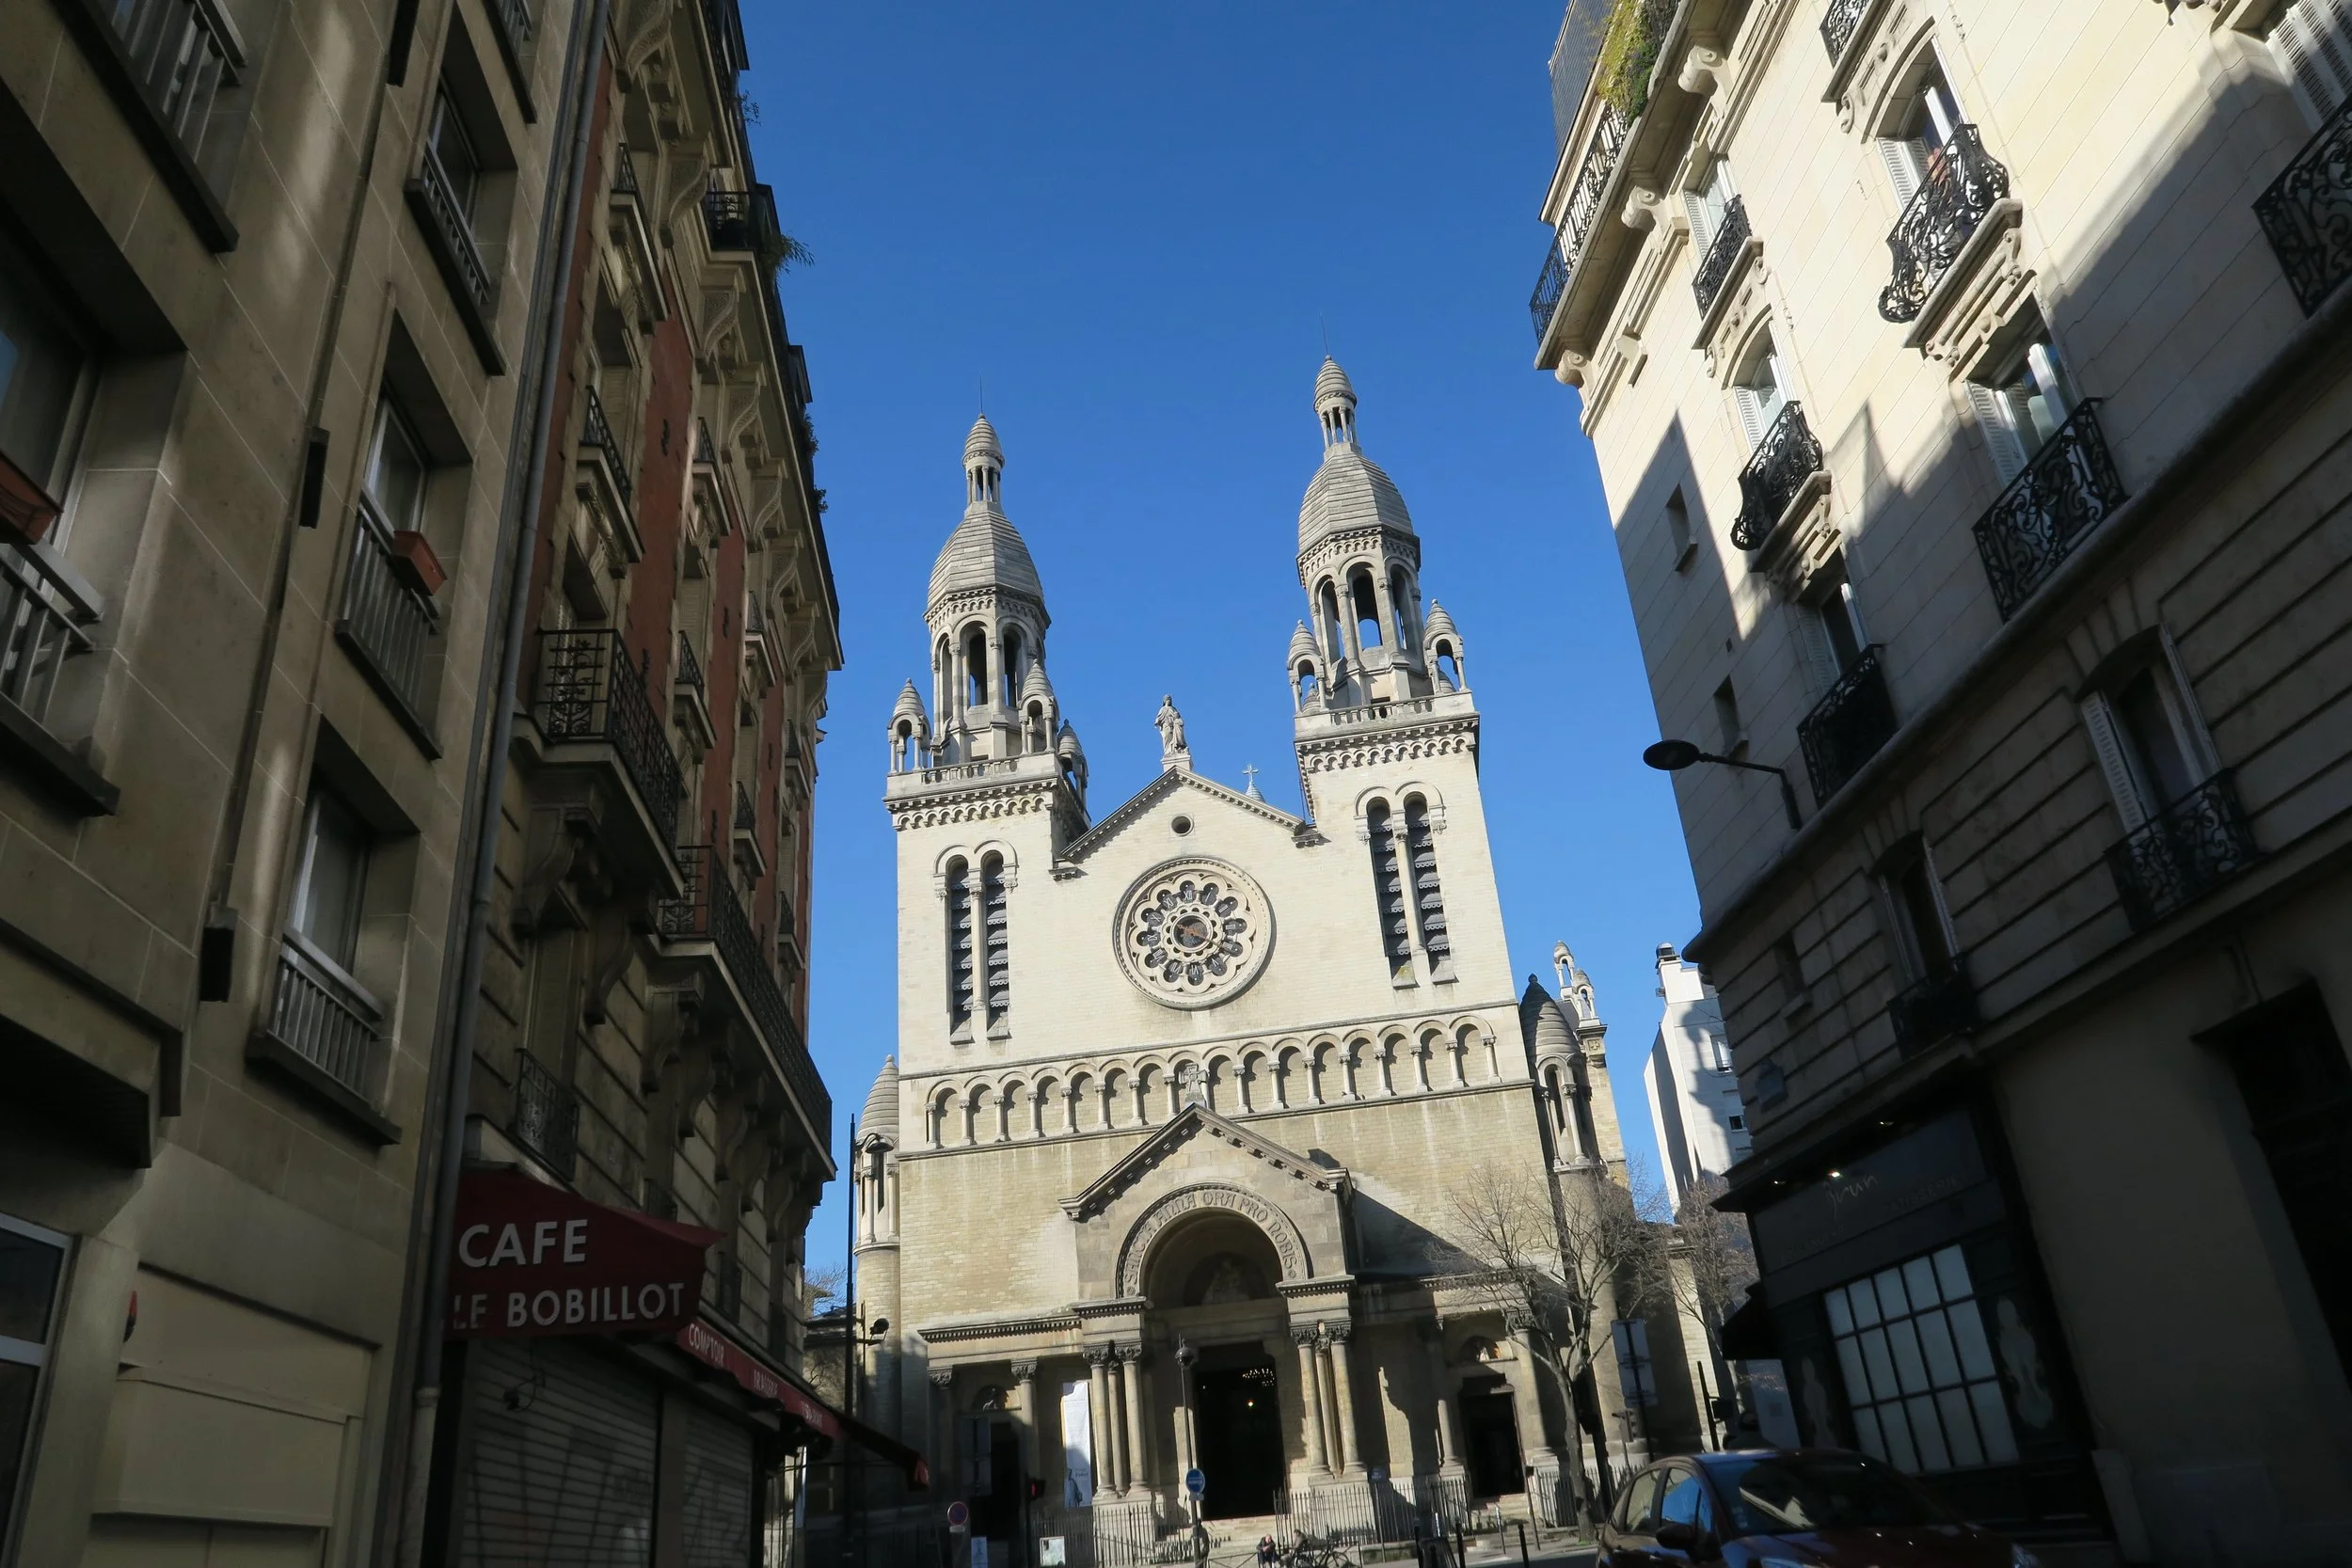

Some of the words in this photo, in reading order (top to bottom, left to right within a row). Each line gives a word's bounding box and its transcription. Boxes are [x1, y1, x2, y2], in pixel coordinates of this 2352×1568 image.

[459, 1219, 588, 1268] CAFE
[1153, 1193, 1198, 1227] ANNA
[1202, 1192, 1237, 1209] ORA
[1238, 1197, 1269, 1224] PRO
[1267, 1222, 1297, 1270] NOBIS
[453, 1293, 487, 1330] LE
[507, 1283, 684, 1328] BOBILLOT
[689, 1323, 724, 1367] COMPTOIR
